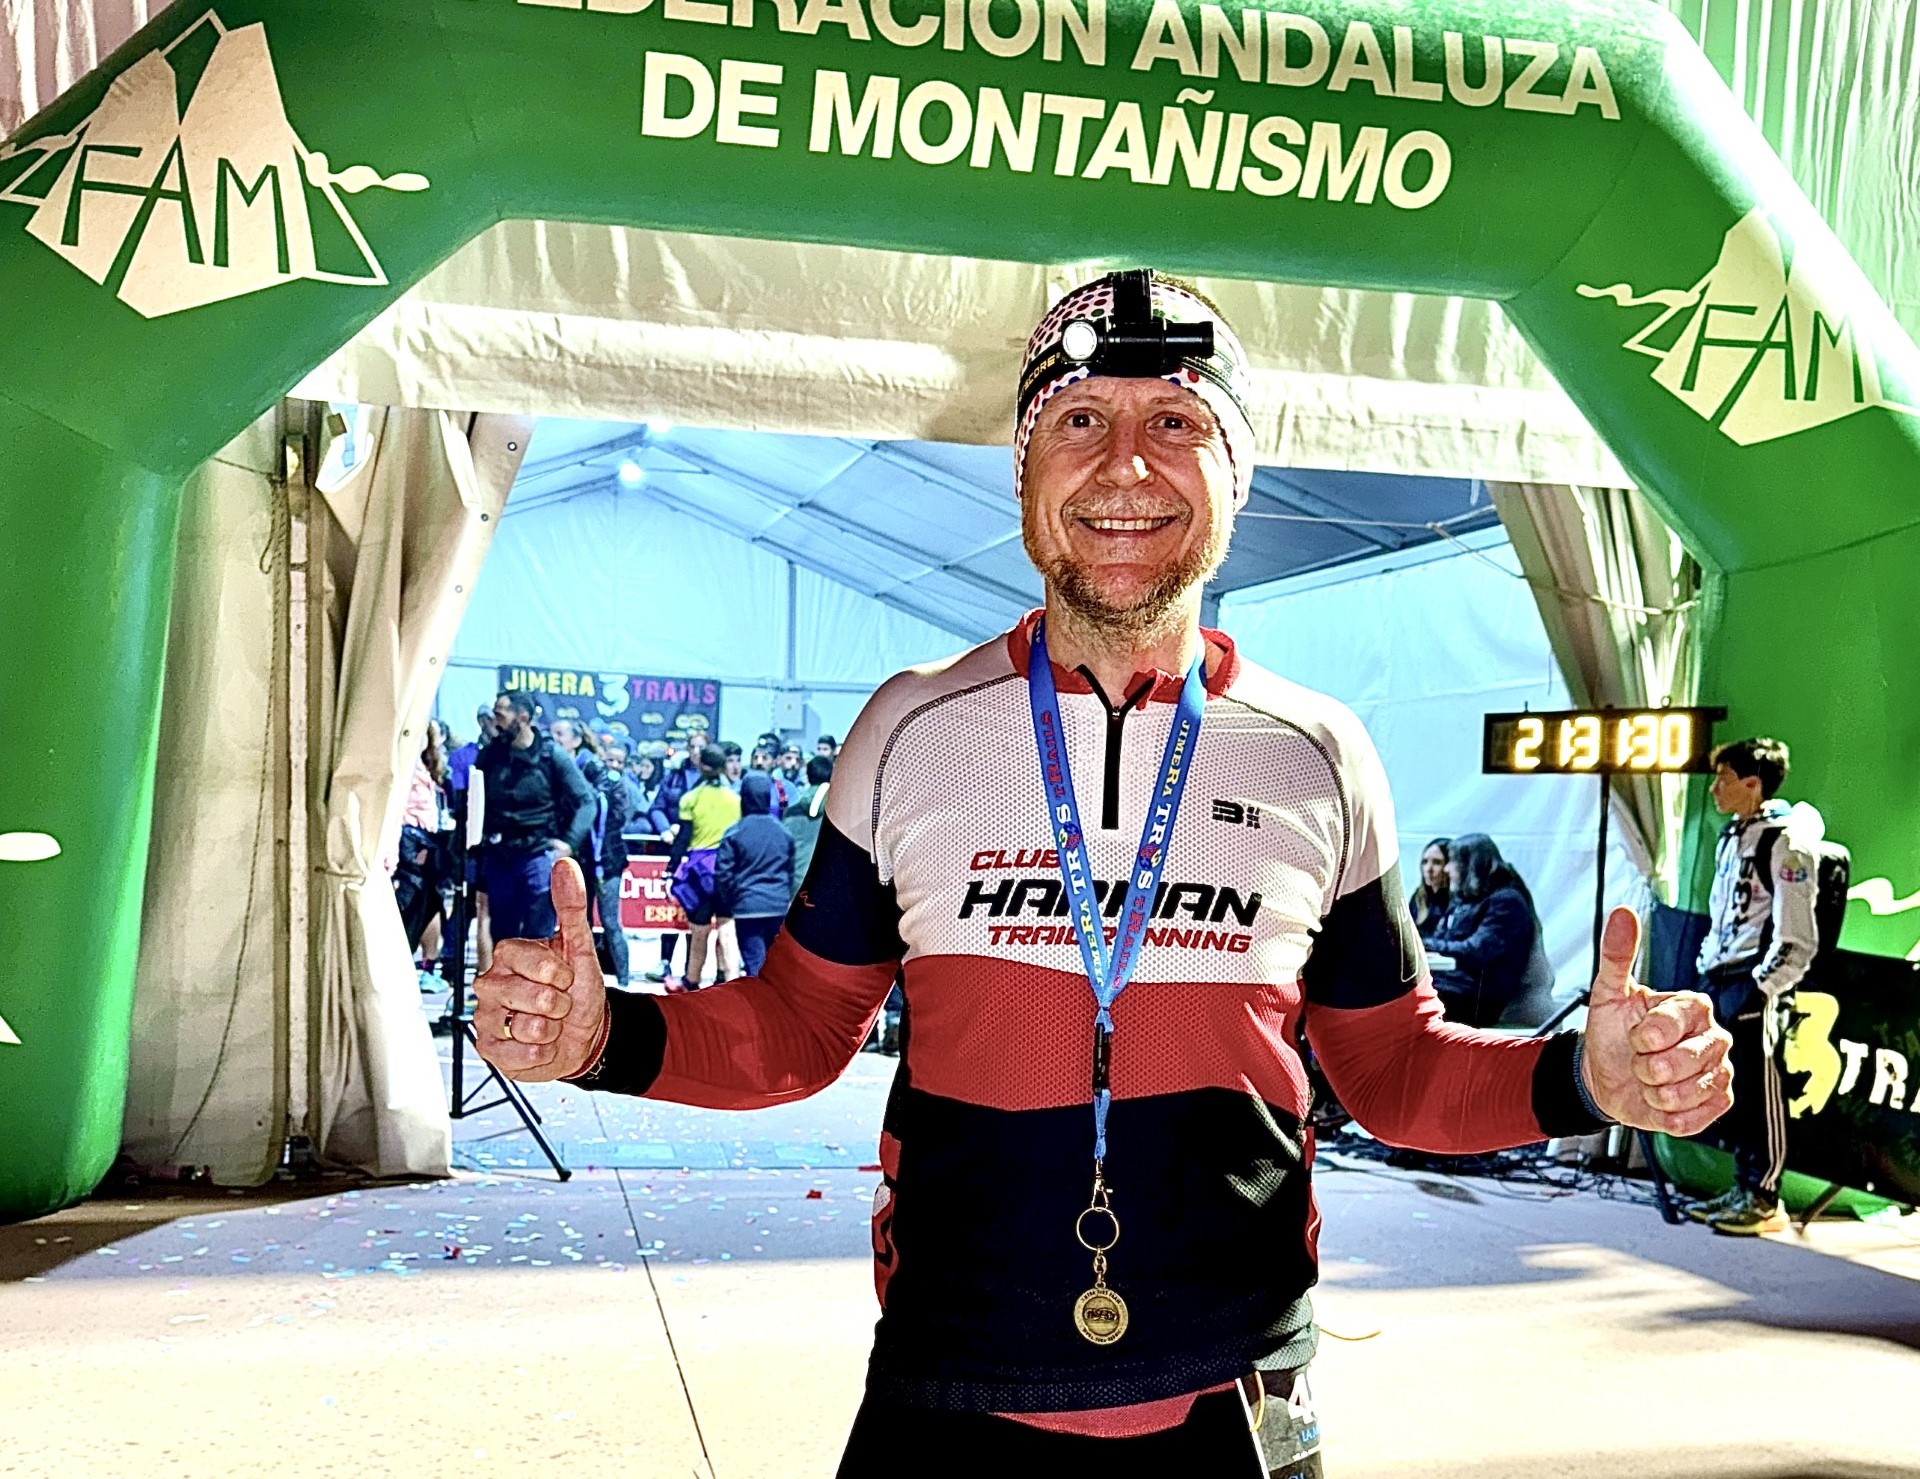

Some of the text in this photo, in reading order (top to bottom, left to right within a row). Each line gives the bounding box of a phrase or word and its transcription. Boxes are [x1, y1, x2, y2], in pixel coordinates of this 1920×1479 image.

[517, 0, 1622, 120] ACION ANDALUZA
[641, 51, 1453, 210] DE MONTAÑISMO
[505, 668, 716, 717] JIMERA 3 TRAILS
[1162, 720, 1191, 797] JIMERA
[969, 849, 1060, 871] CLUB
[1079, 898, 1105, 988] JIMERA
[1096, 927, 1253, 954] RNNING
